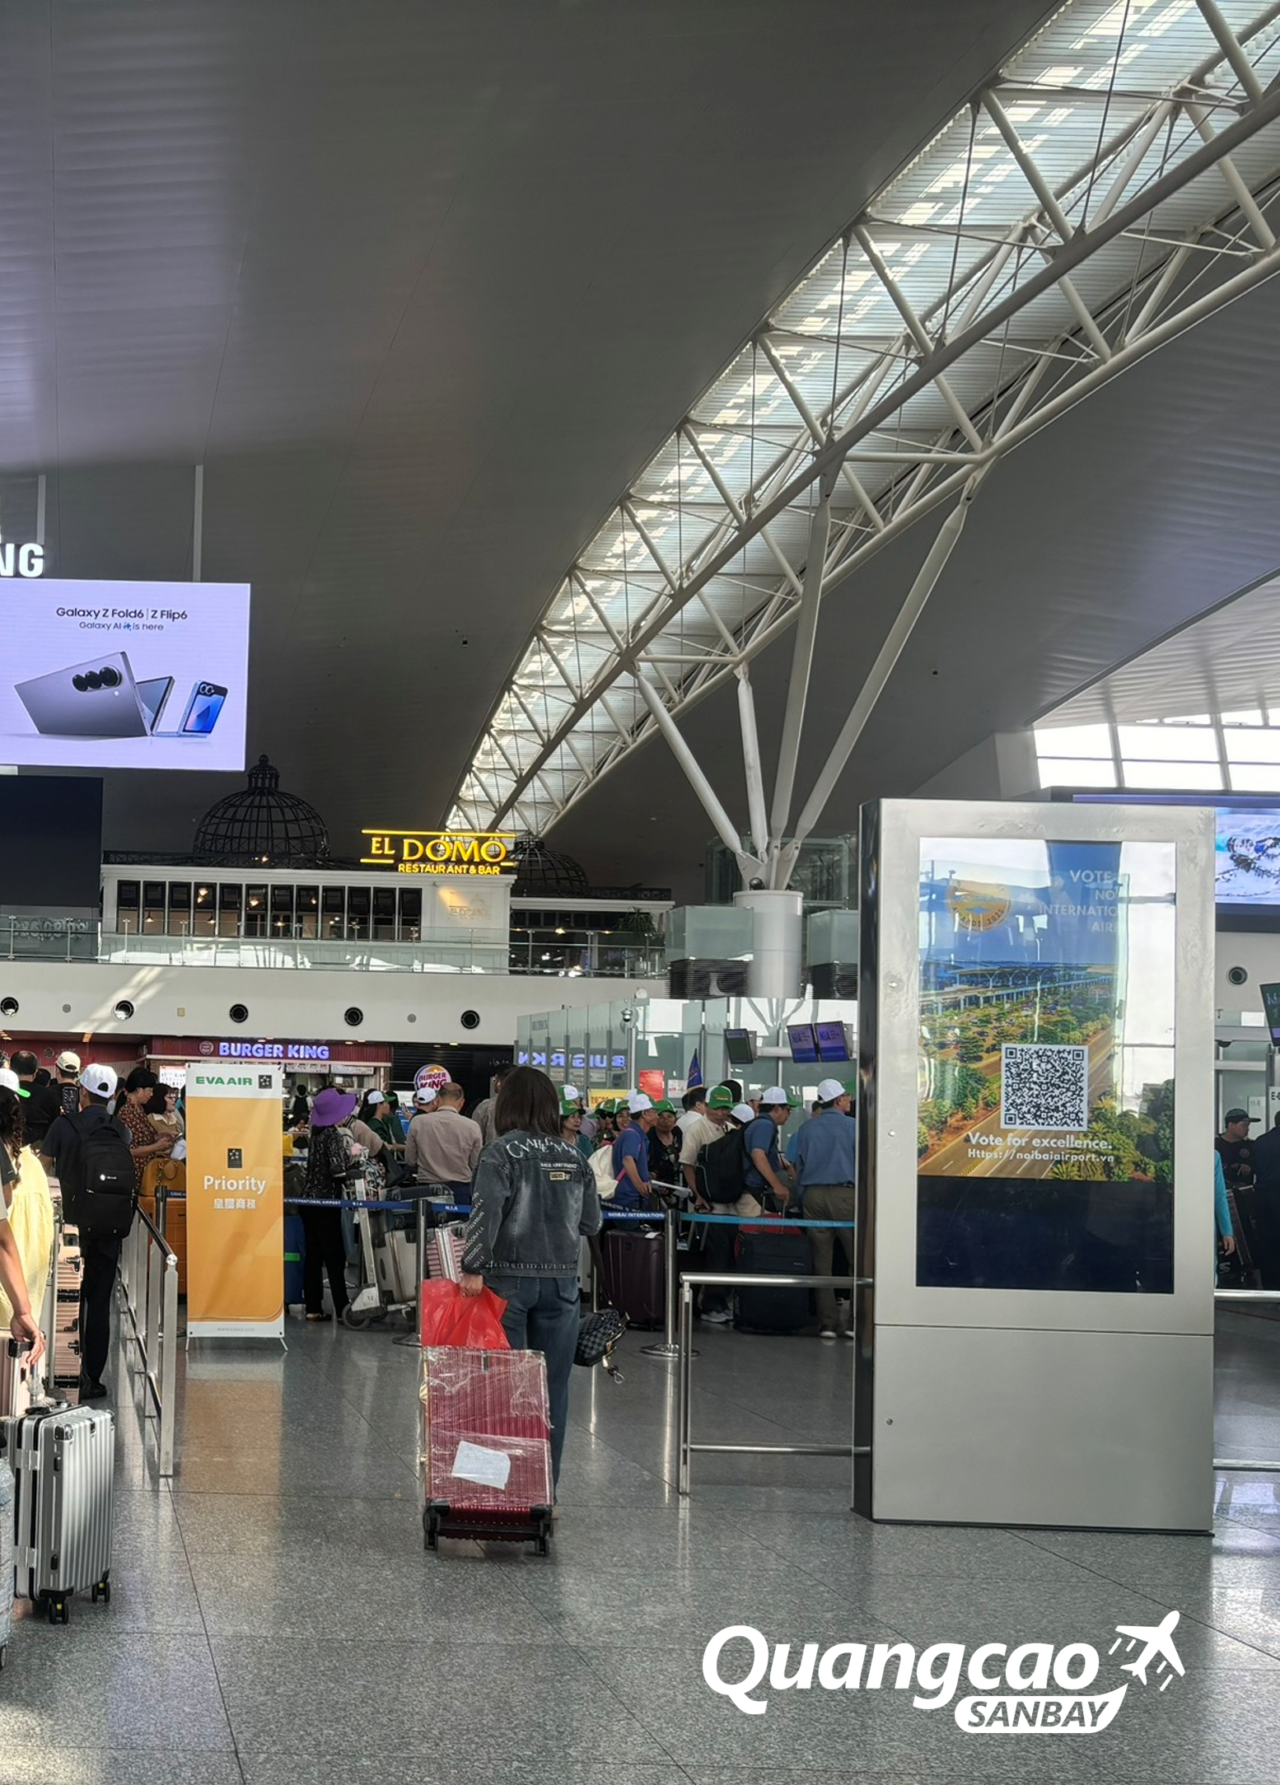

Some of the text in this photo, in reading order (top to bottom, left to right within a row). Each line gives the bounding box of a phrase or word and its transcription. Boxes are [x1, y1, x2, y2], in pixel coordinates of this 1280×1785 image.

[56, 607, 188, 622] Galaxy Z Fold6 Z Flip6
[79, 621, 112, 631] Galaxy
[142, 623, 164, 631] here
[371, 837, 507, 863] EL DOMO
[398, 864, 501, 875] RESTAURANT & BAR
[1070, 869, 1113, 884] VOTE
[219, 1042, 284, 1058] BURGER
[287, 1045, 330, 1059] KING
[195, 1076, 253, 1086] EVA AIR
[420, 1072, 446, 1081] BURGER
[968, 1132, 1113, 1149] Vote for excellence.
[968, 1148, 1114, 1162] Https://noibaiairport.vn
[204, 1175, 266, 1195] Priority
